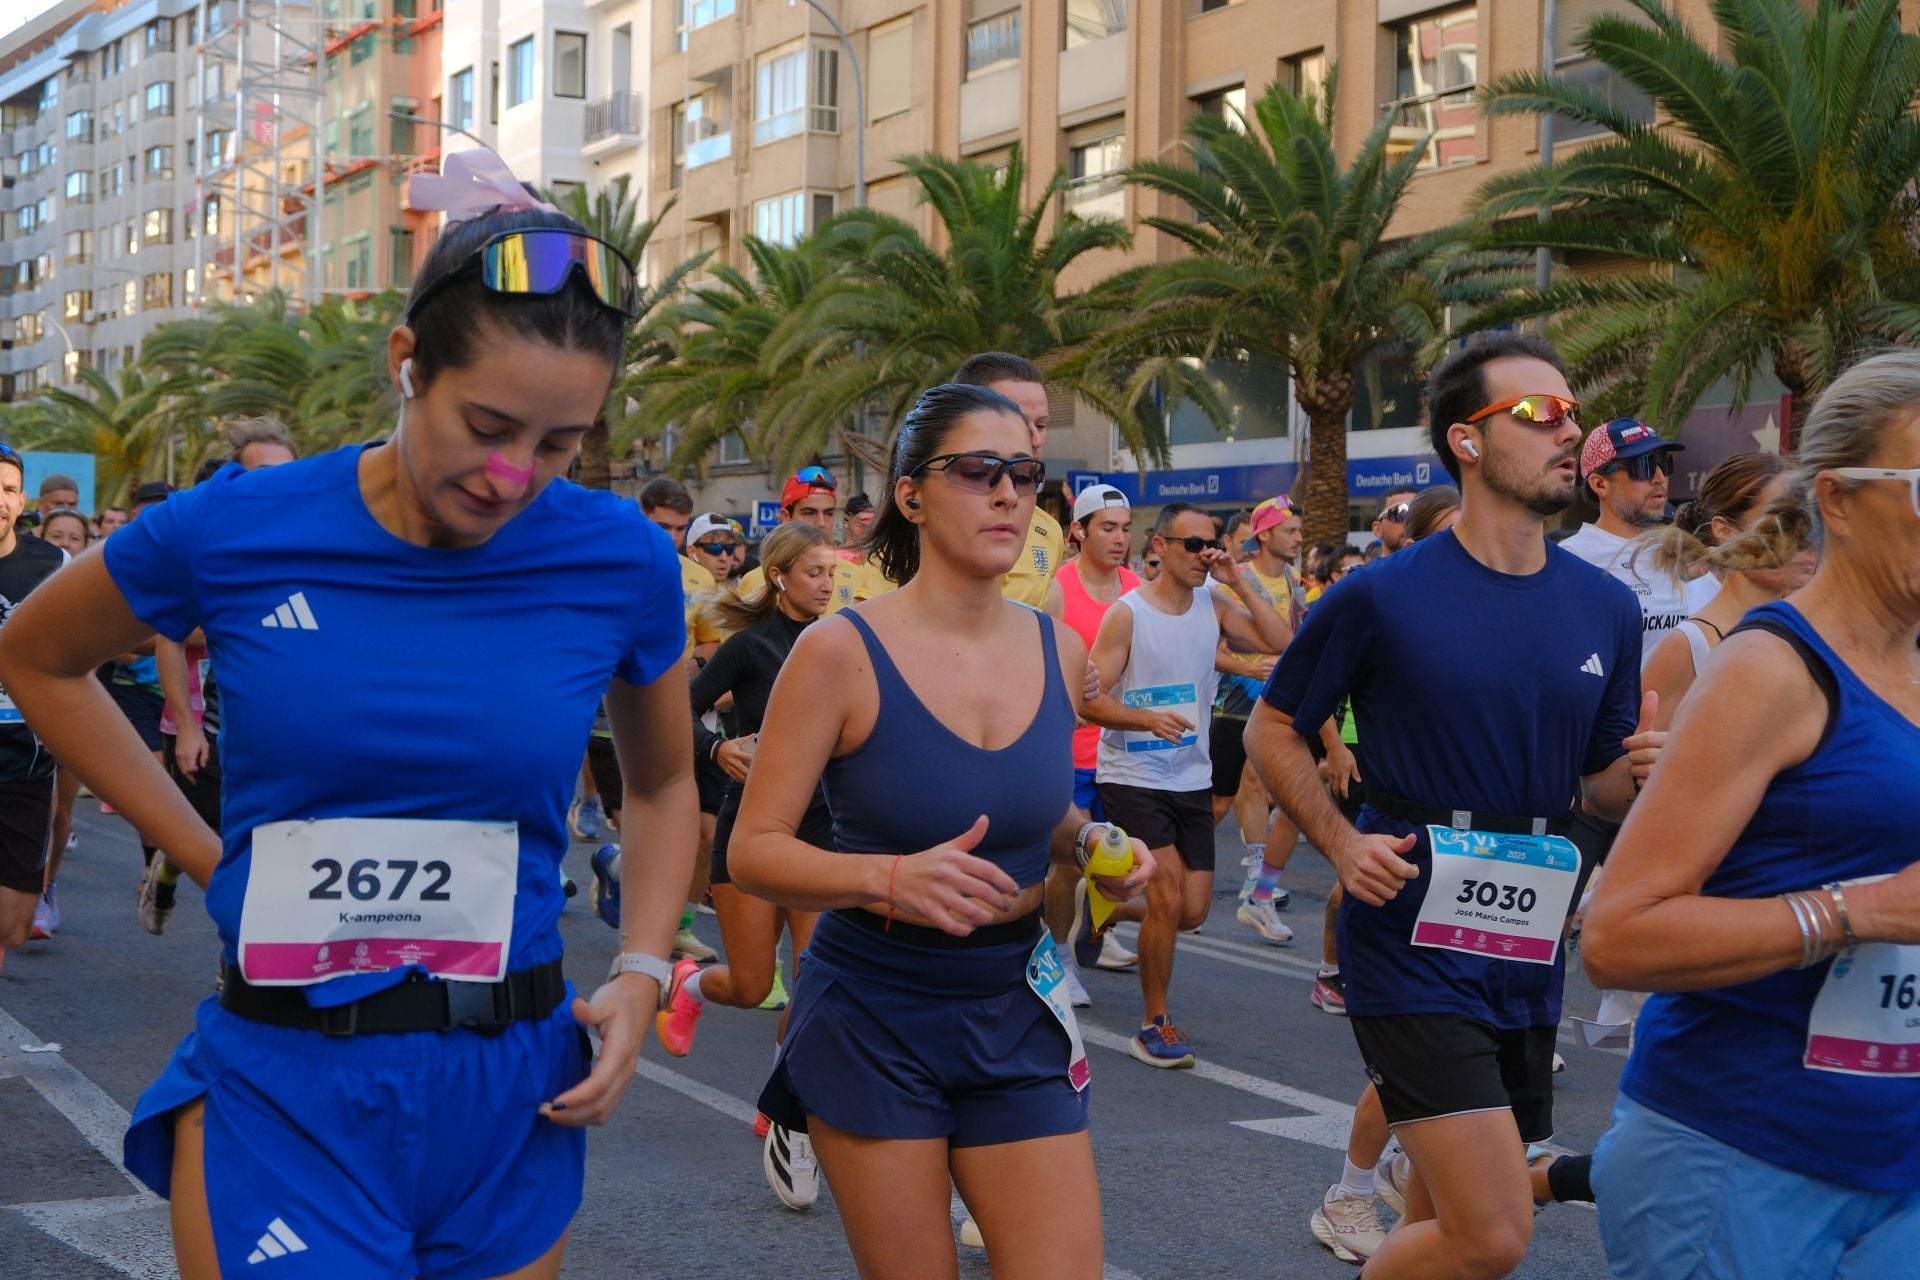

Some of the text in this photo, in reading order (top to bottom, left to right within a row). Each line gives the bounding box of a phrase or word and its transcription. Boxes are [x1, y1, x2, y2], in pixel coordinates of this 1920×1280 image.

[1355, 472, 1414, 487] Deutsche Bank
[1159, 482, 1206, 496] Deutsche Bank
[1507, 851, 1527, 860] 2025
[309, 858, 451, 901] 2672
[1456, 879, 1537, 913] 3030
[339, 912, 422, 924] K-ampeona
[1455, 908, 1529, 926] José María Campos
[1880, 974, 1920, 1010] 16
